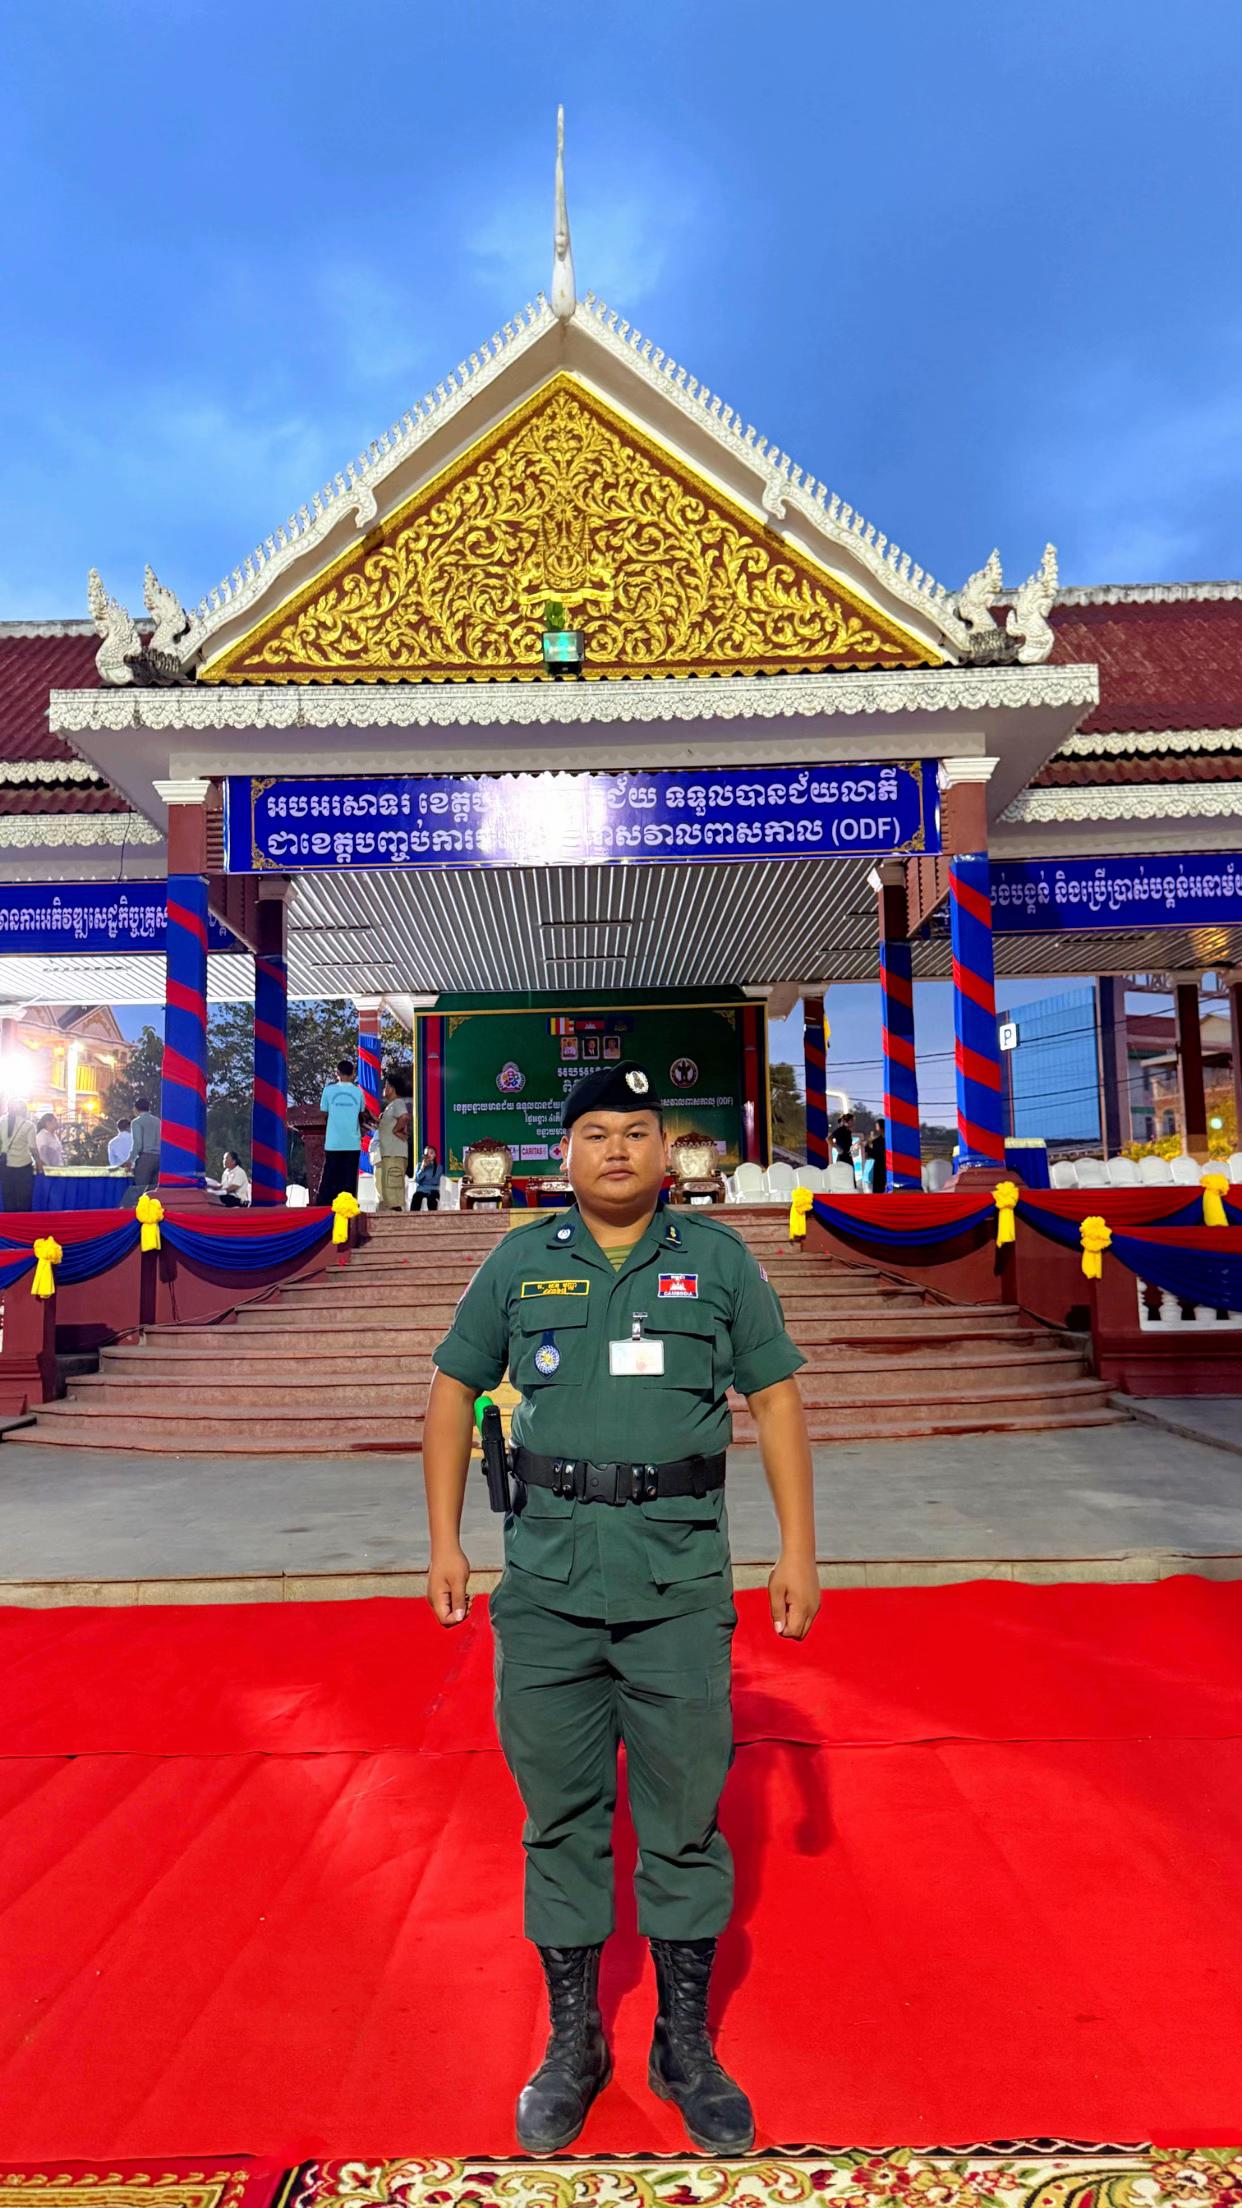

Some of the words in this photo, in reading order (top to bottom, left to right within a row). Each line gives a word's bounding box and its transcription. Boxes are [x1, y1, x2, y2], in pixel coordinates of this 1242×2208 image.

[267, 792, 411, 818] អបអរសាទរ
[664, 768, 898, 817] ទទួលបានជ័យលាភី
[831, 817, 901, 846] (ODF)
[1004, 1028, 1012, 1046] P
